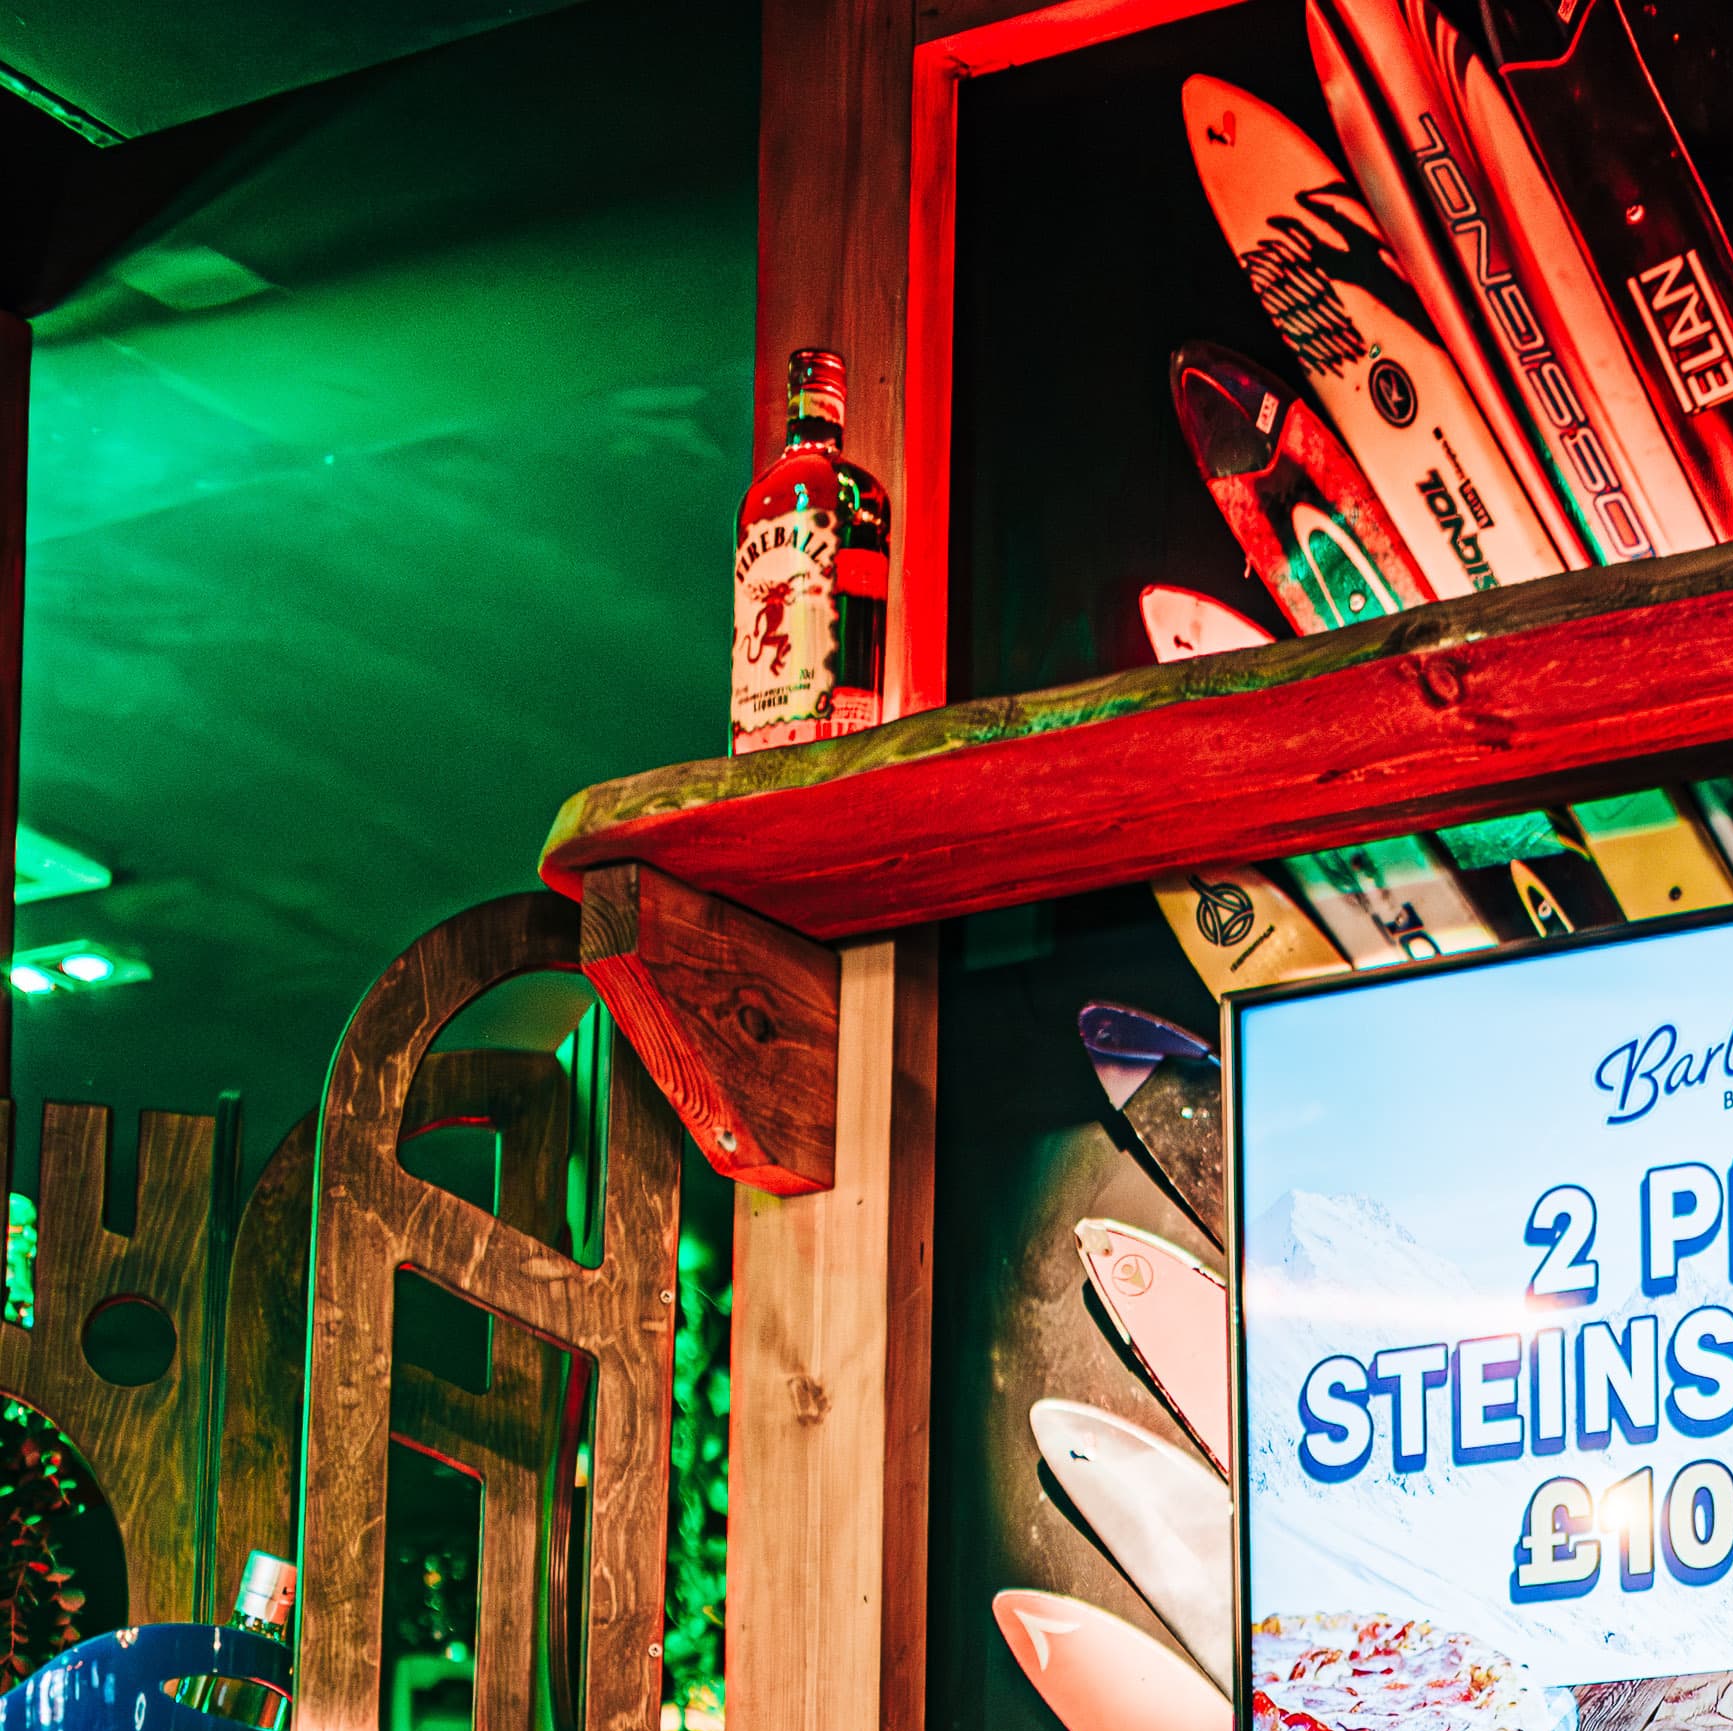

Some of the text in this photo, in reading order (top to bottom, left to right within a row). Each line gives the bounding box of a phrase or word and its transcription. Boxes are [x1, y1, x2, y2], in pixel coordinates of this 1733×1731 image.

[1409, 112, 1656, 566] OSSIGNOL
[735, 525, 829, 584] FIREBALL
[1527, 1184, 1598, 1306] 2
